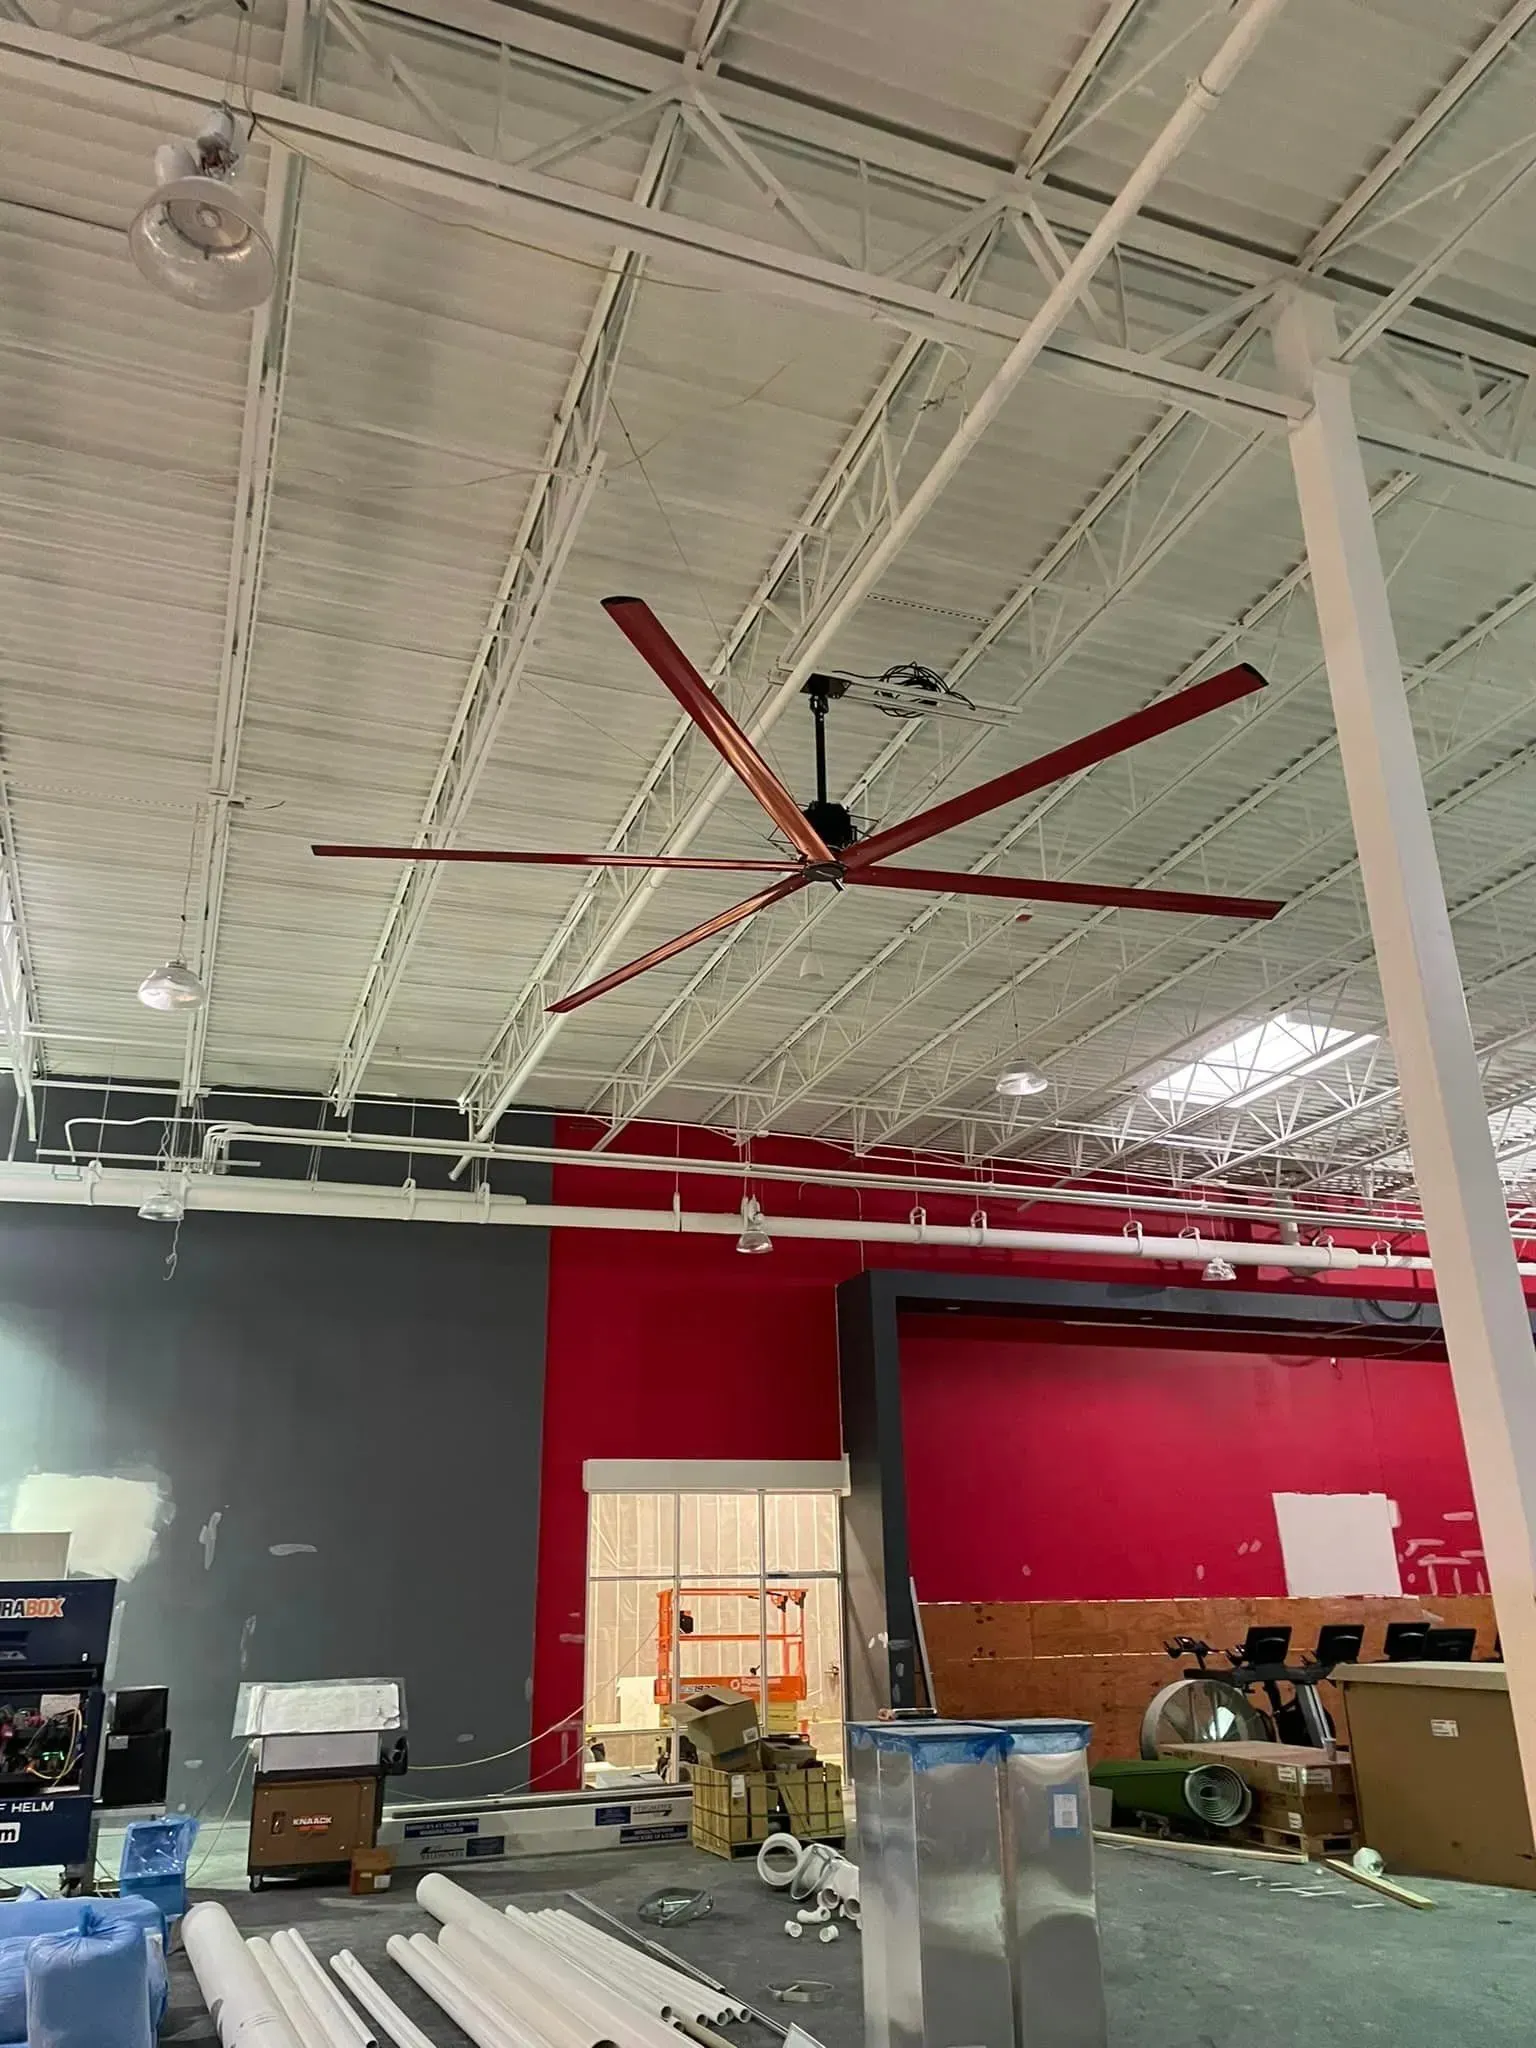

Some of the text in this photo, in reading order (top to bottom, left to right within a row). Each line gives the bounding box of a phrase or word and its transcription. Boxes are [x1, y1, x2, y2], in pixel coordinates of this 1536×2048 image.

[0, 1598, 64, 1618] RABOX
[11, 1801, 54, 1813] HELM
[292, 1816, 333, 1826] KNAACK
